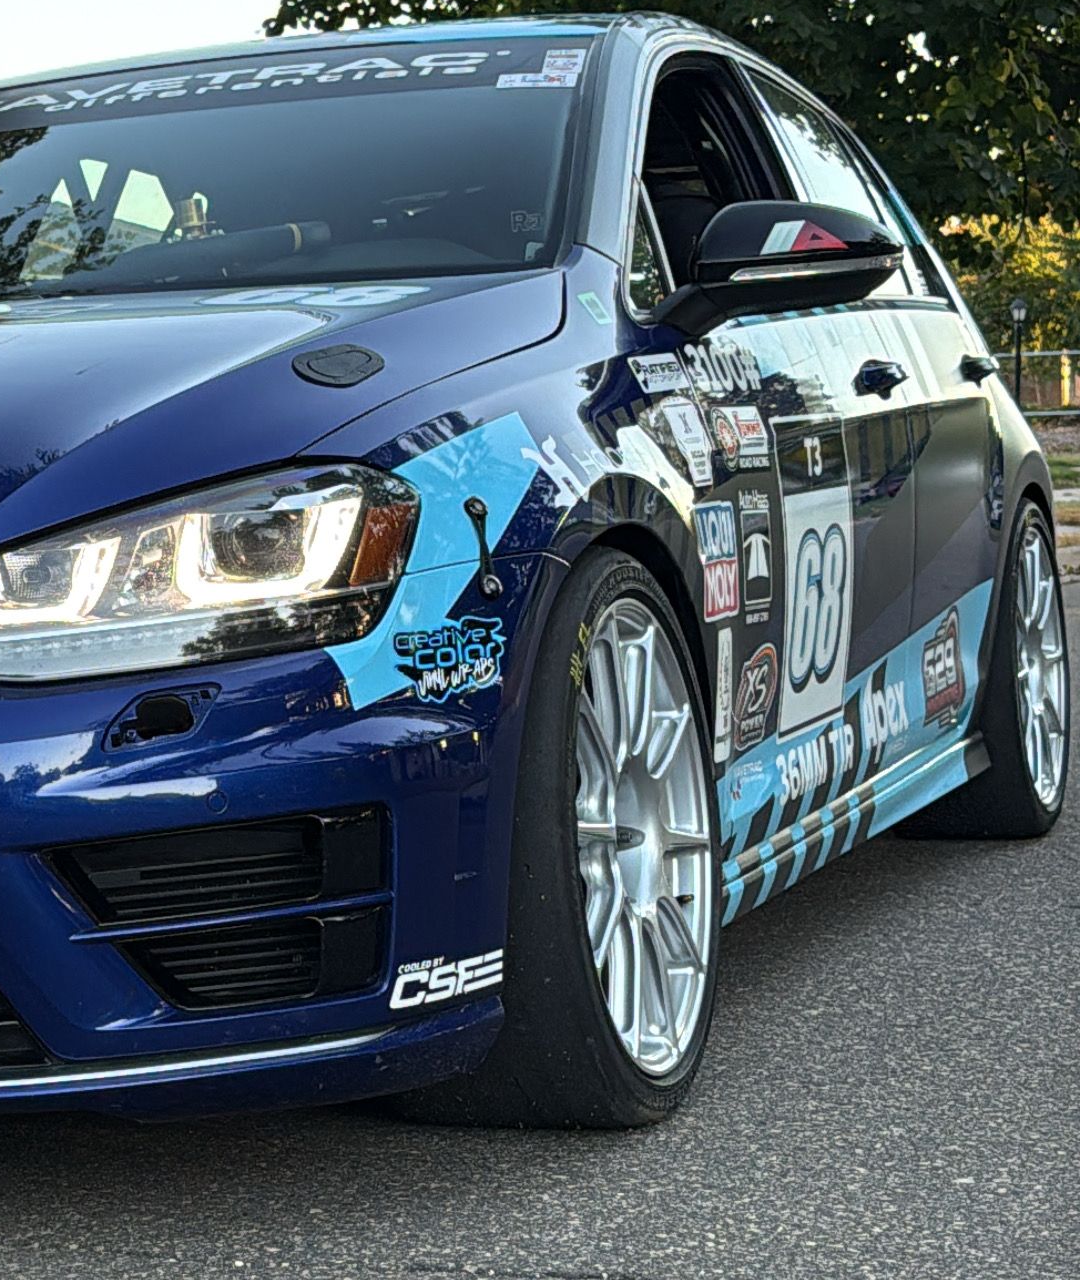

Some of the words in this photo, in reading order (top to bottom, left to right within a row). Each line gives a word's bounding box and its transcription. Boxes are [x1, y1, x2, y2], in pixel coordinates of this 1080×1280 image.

[803, 437, 822, 477] T3
[696, 508, 734, 557] LIQUI
[705, 562, 737, 613] MOLY
[789, 523, 847, 693] 68
[863, 670, 909, 764] Apex
[776, 735, 827, 806] 36MM
[397, 959, 432, 974] COOLED
[433, 956, 444, 967] BY
